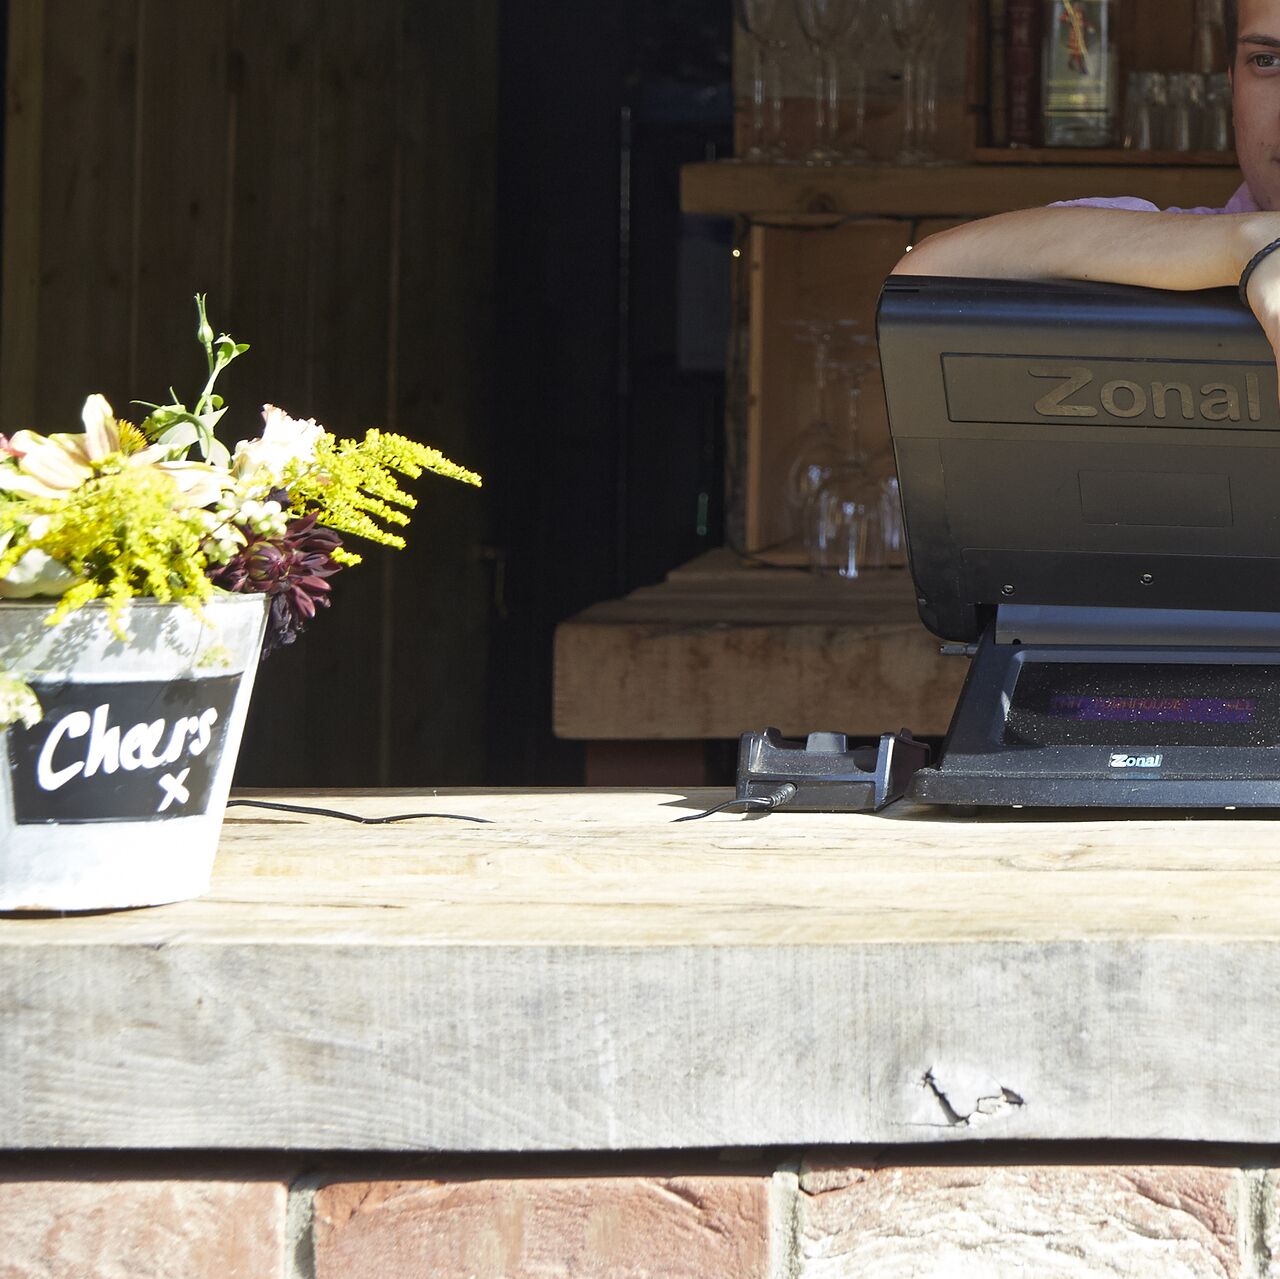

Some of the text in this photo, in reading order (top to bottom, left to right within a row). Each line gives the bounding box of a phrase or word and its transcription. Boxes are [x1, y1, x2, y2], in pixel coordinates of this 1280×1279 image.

[1028, 366, 1261, 421] Zonal
[38, 703, 218, 791] Cheers
[1109, 753, 1162, 768] Zonal
